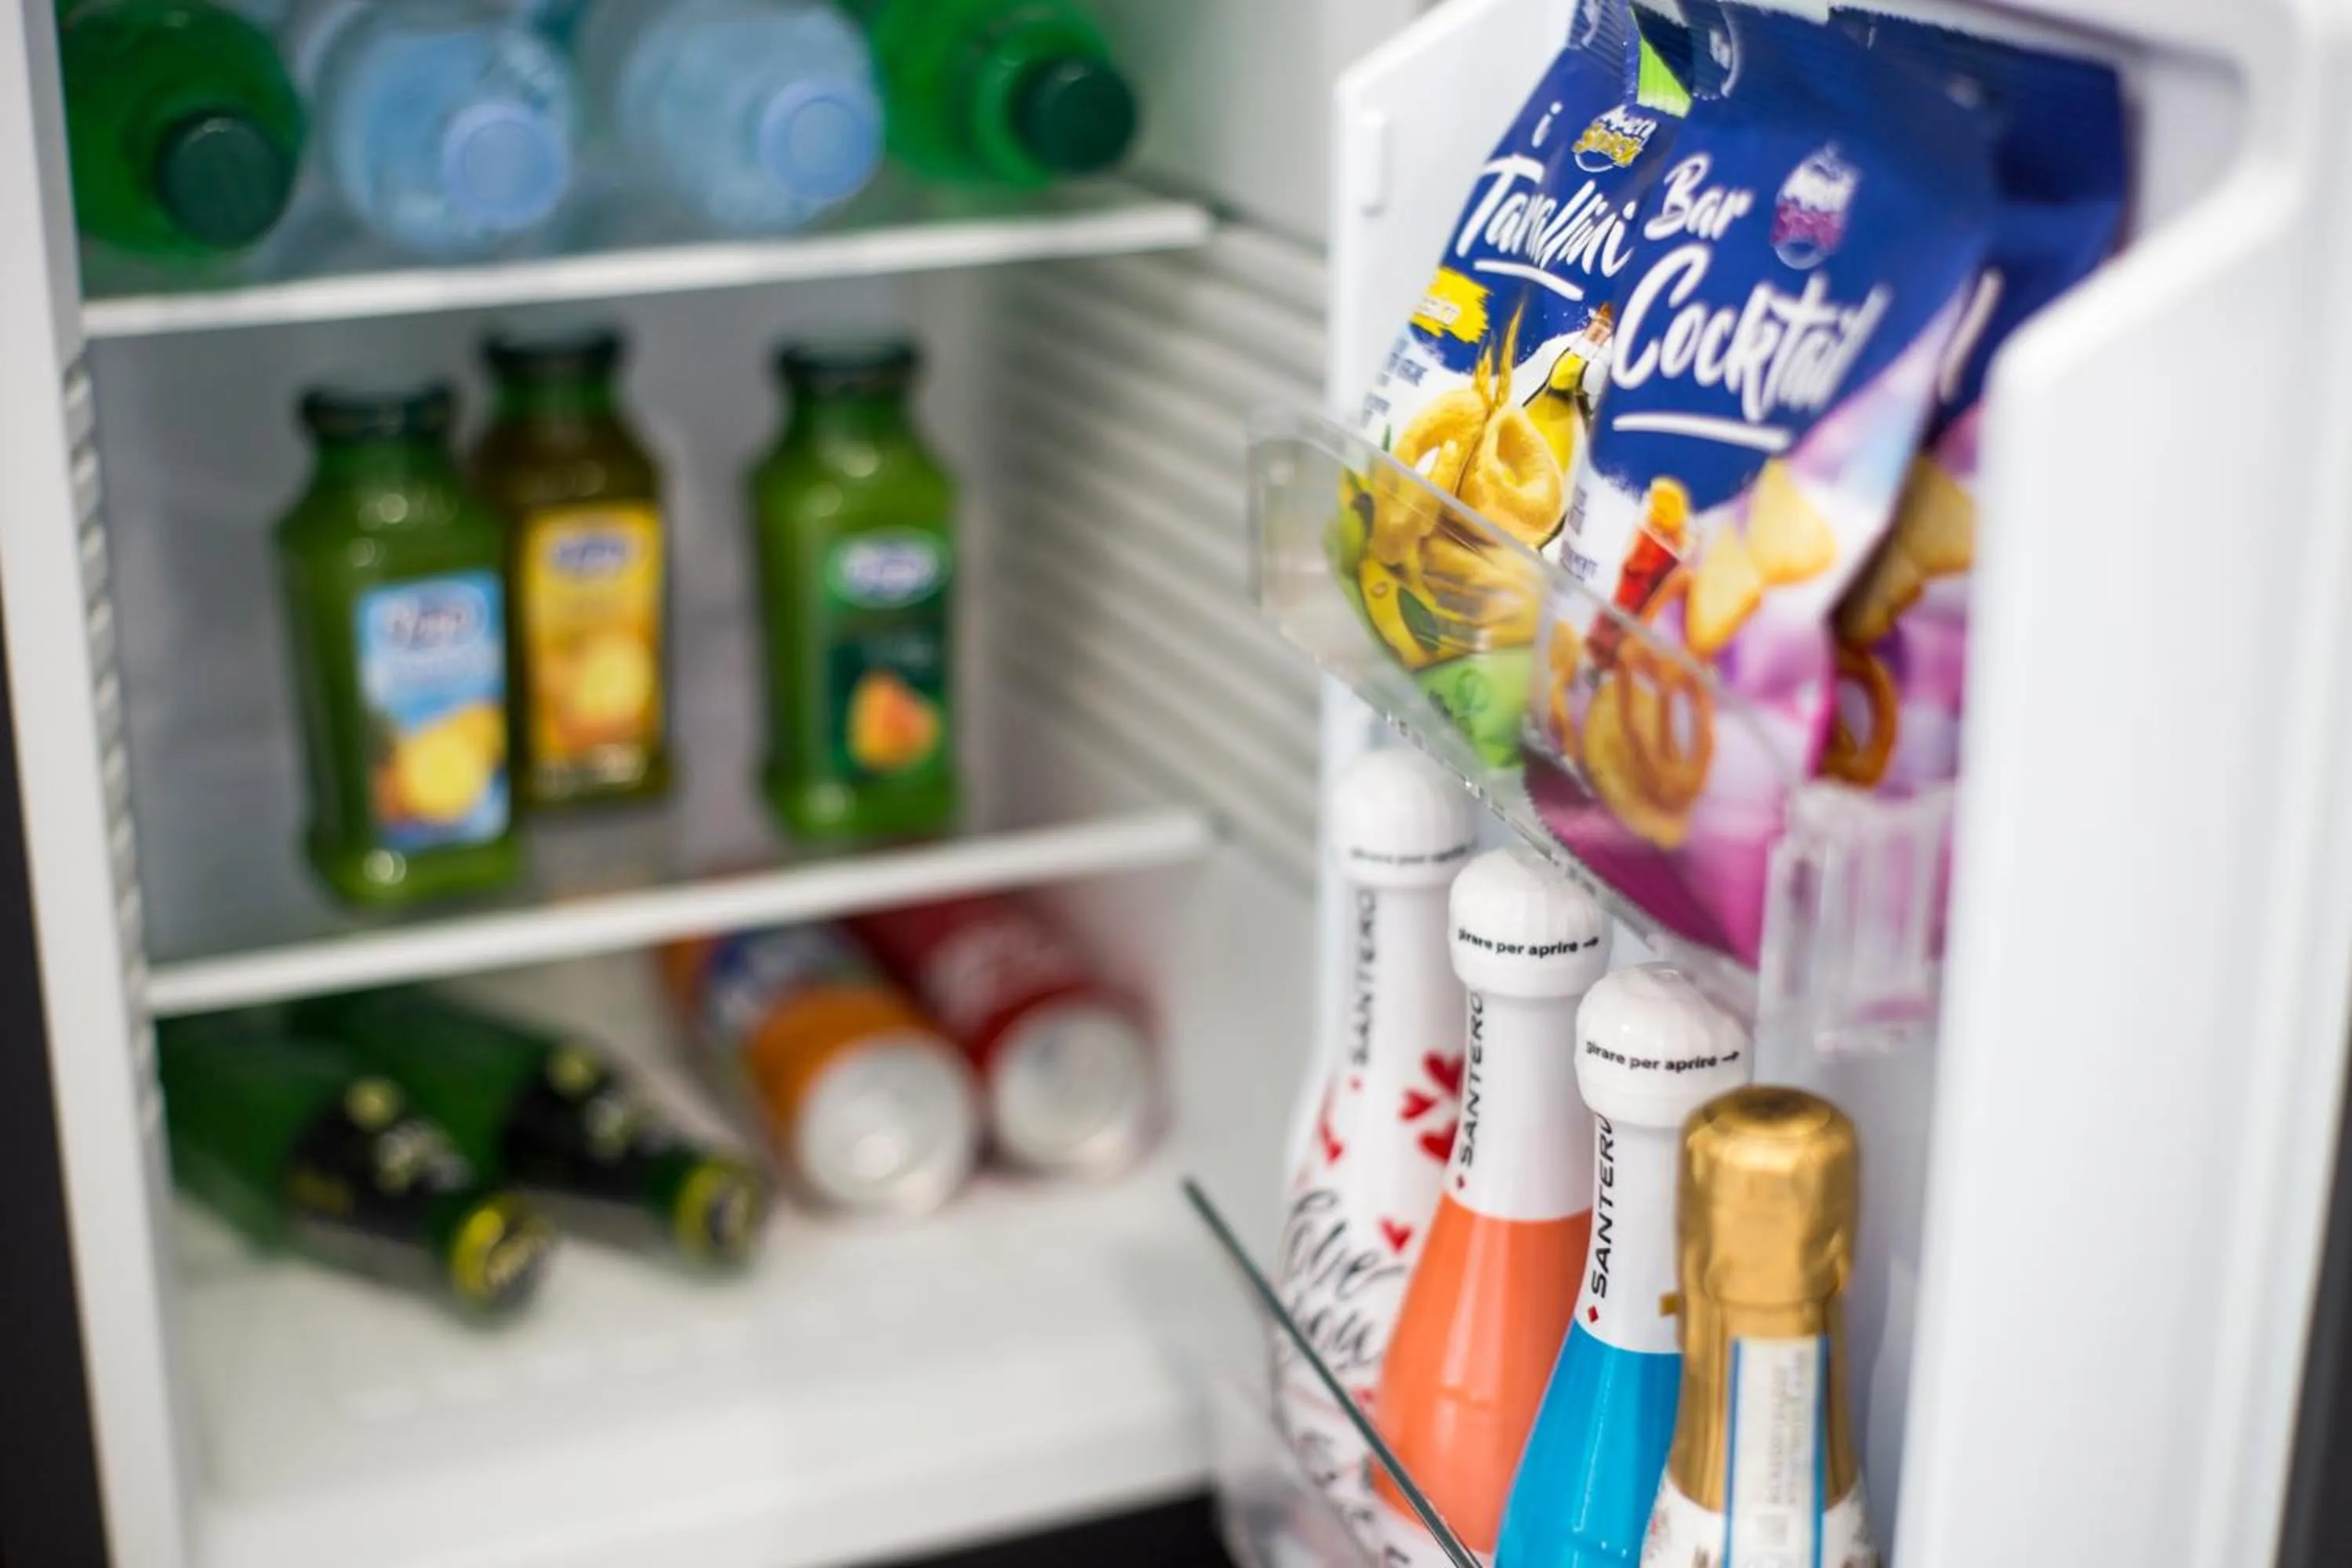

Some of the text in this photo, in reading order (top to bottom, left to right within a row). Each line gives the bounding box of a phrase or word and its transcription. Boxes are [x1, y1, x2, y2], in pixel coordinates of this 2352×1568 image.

[1531, 101, 1563, 148] i
[1643, 154, 1754, 241] Bar
[1495, 942, 1525, 955] per
[1528, 941, 1578, 959] aprire
[1460, 991, 1484, 1167] SANTERO
[1628, 1056, 1661, 1071] per
[1664, 1055, 1717, 1074] aprire
